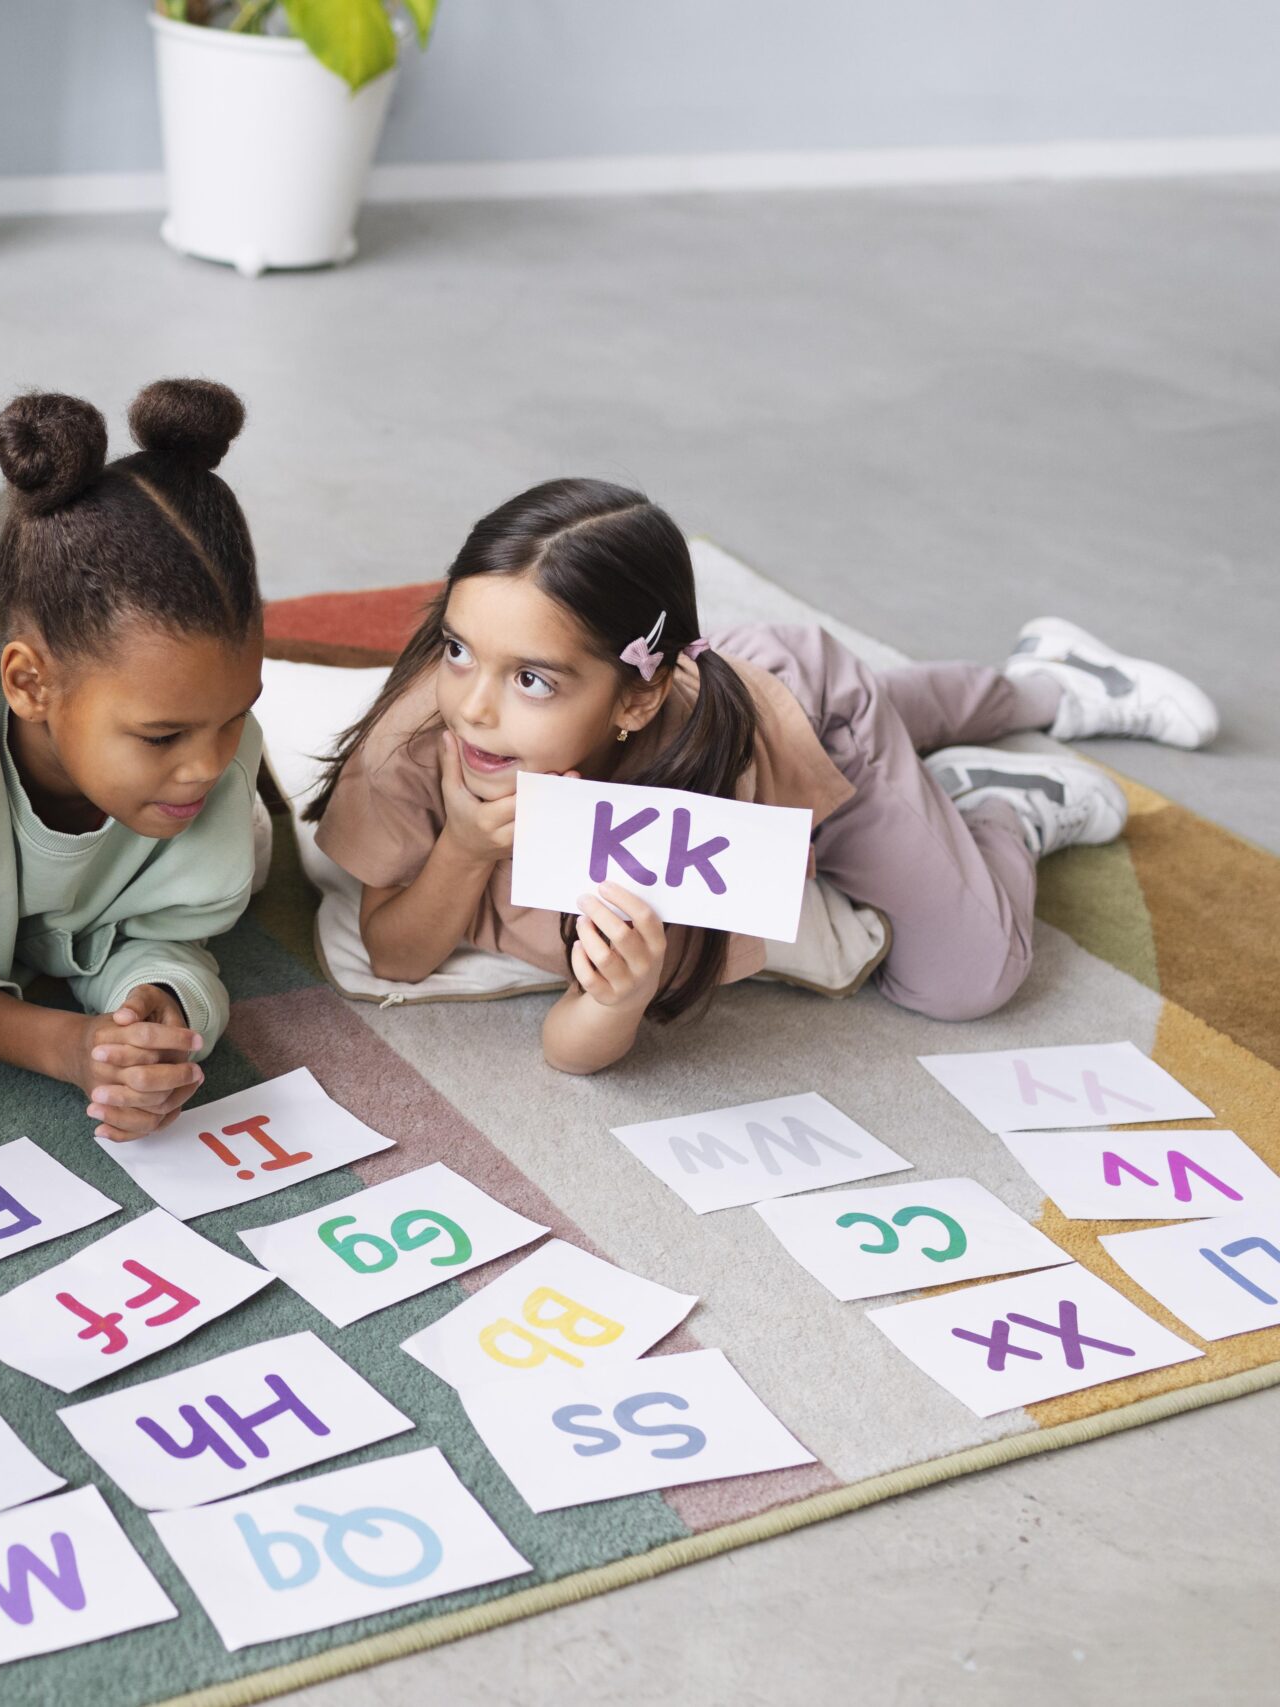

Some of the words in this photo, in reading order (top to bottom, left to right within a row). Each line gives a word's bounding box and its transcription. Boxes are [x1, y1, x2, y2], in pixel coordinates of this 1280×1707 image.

[589, 801, 730, 895] Kk
[1012, 1059, 1154, 1115] Yy
[198, 1115, 314, 1181] Ii
[668, 1116, 863, 1176] Ww
[1102, 1150, 1243, 1202] Vv
[317, 1209, 472, 1275] Gg
[836, 1205, 968, 1263] Cc
[55, 1258, 201, 1355] Ff
[478, 1286, 625, 1369] Bb
[951, 1299, 1136, 1372] Xx
[135, 1374, 332, 1471] Hh
[551, 1391, 707, 1460] Ss
[234, 1504, 443, 1591] Qq
